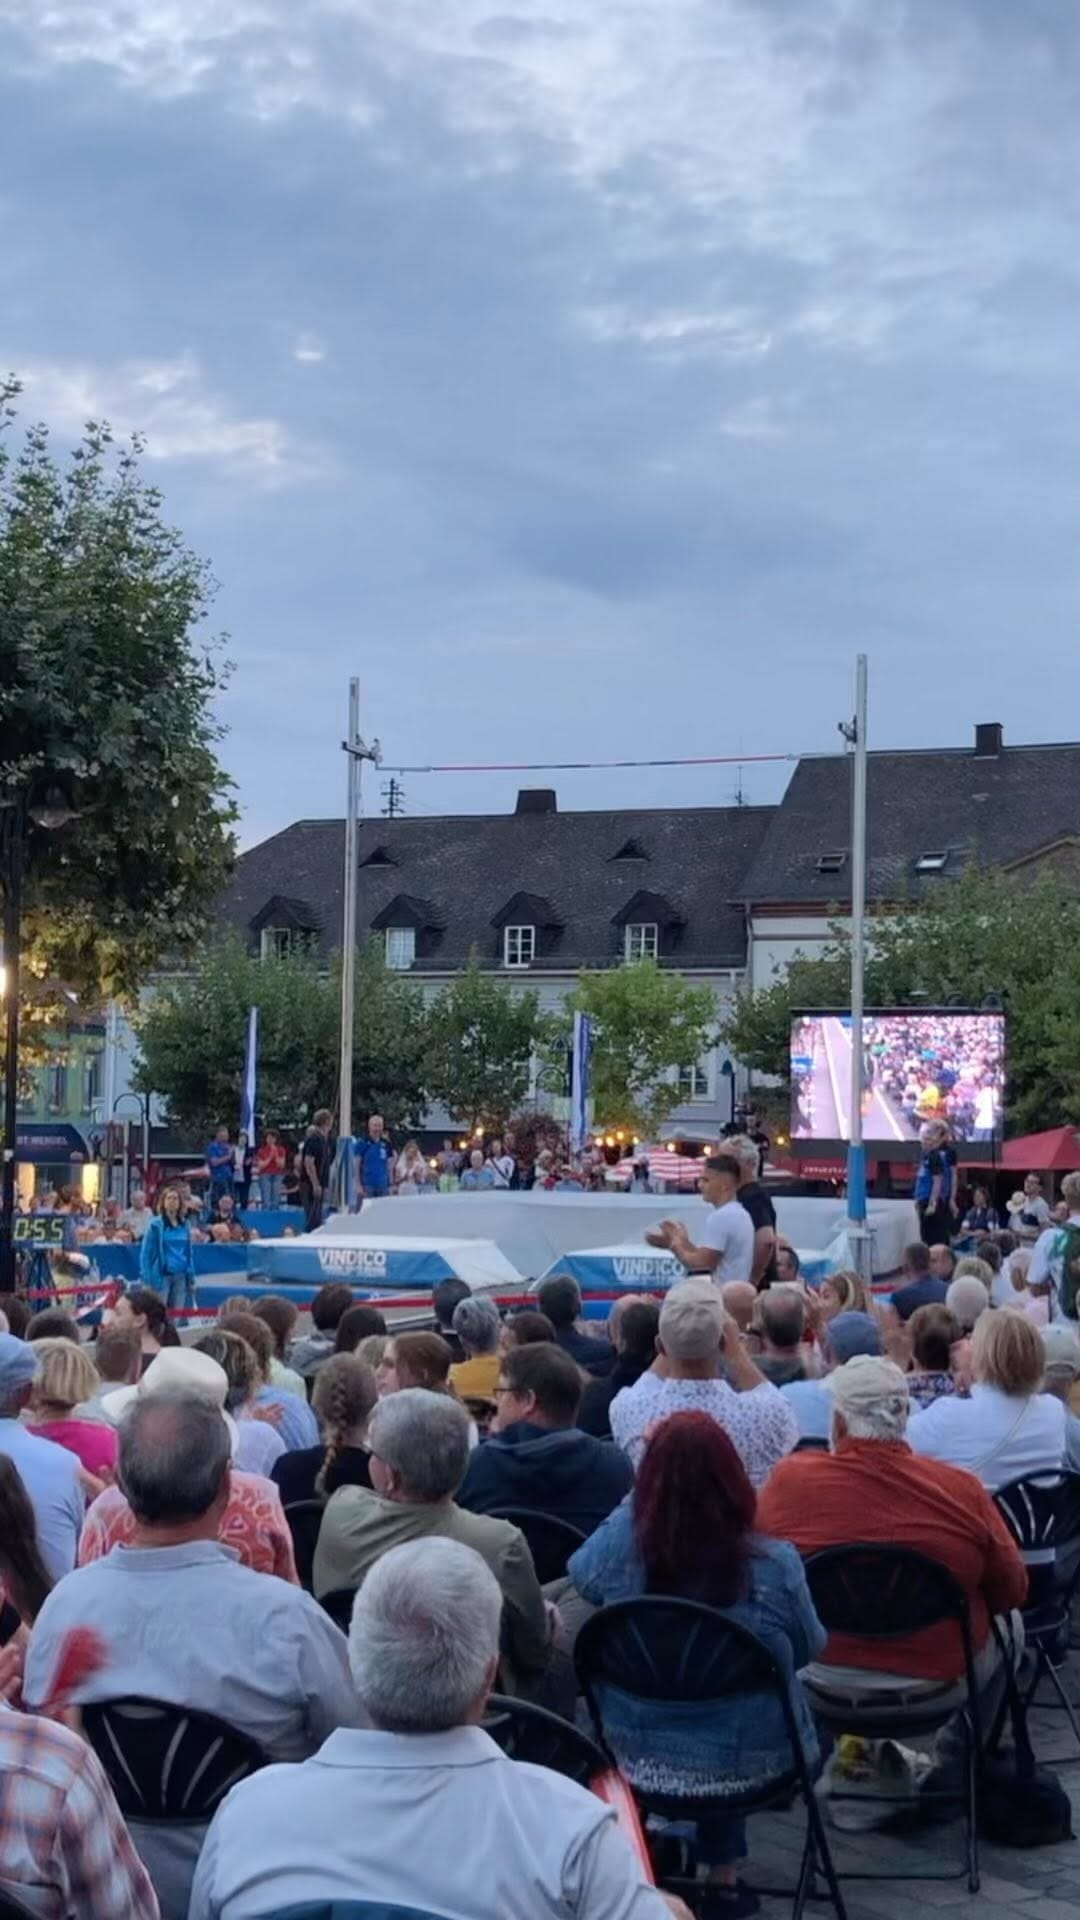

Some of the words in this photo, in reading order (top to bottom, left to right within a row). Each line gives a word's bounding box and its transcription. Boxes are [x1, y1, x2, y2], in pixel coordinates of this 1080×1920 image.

[13, 1218, 63, 1240] 0:55
[317, 1248, 387, 1265] VINDICO
[612, 1258, 685, 1276] VINDICO
